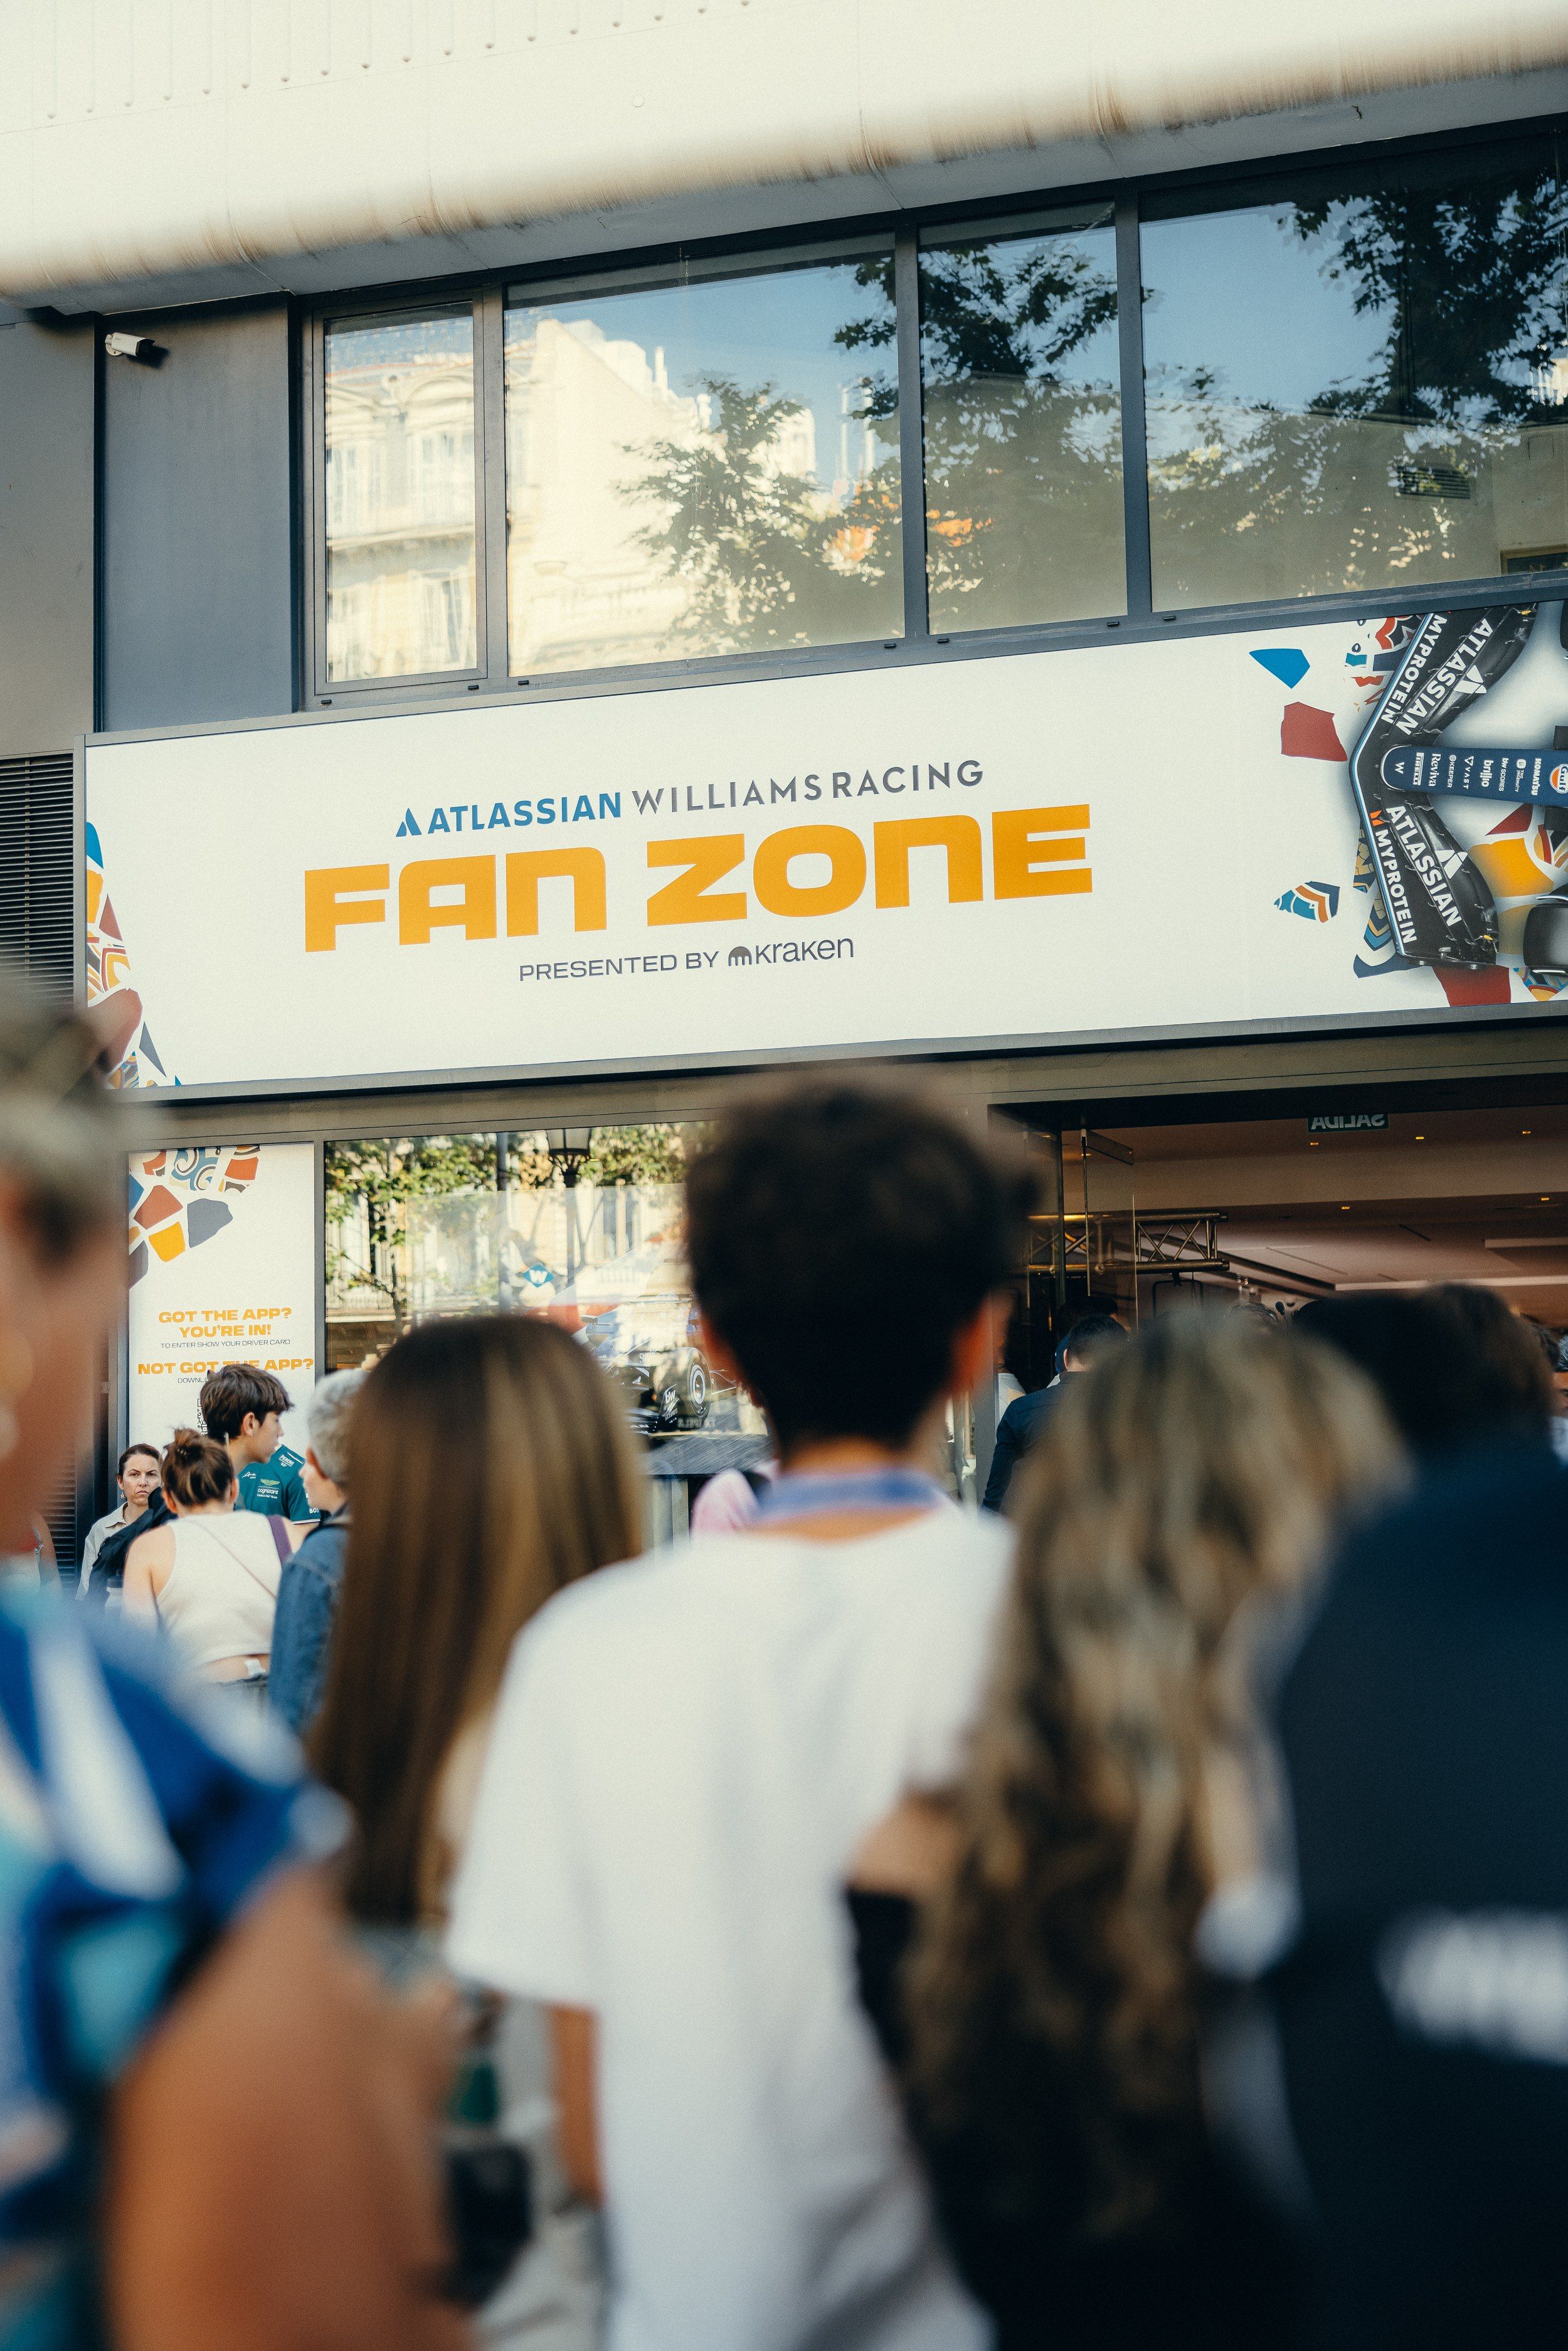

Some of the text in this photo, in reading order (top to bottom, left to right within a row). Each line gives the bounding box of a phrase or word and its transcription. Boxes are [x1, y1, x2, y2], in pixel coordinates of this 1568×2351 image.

[1380, 614, 1448, 724] MYPROTEIN
[1396, 618, 1493, 736] ATLASSIAN
[1412, 752, 1424, 786] PIRELLI
[1428, 753, 1441, 787] Reviva
[1447, 762, 1455, 788] KEEPER
[1498, 769, 1507, 792] SCORES
[1531, 758, 1542, 796] KOMATSU
[1559, 765, 1568, 792] Gulf
[427, 759, 984, 835] ATLASSIAN WILLIAMS RACING
[304, 804, 1093, 953] FAN ZONE
[1385, 805, 1463, 927] ATLASSIAN
[1375, 829, 1417, 944] MYPROTEIN
[519, 953, 677, 982] PRESENTED
[686, 950, 719, 970] BY
[159, 1307, 292, 1324] GOT THE APP?
[179, 1324, 271, 1338] YOU'RE IN!
[138, 1362, 176, 1375] NOT
[180, 1361, 219, 1374] GOT
[264, 1358, 314, 1371] APP?
